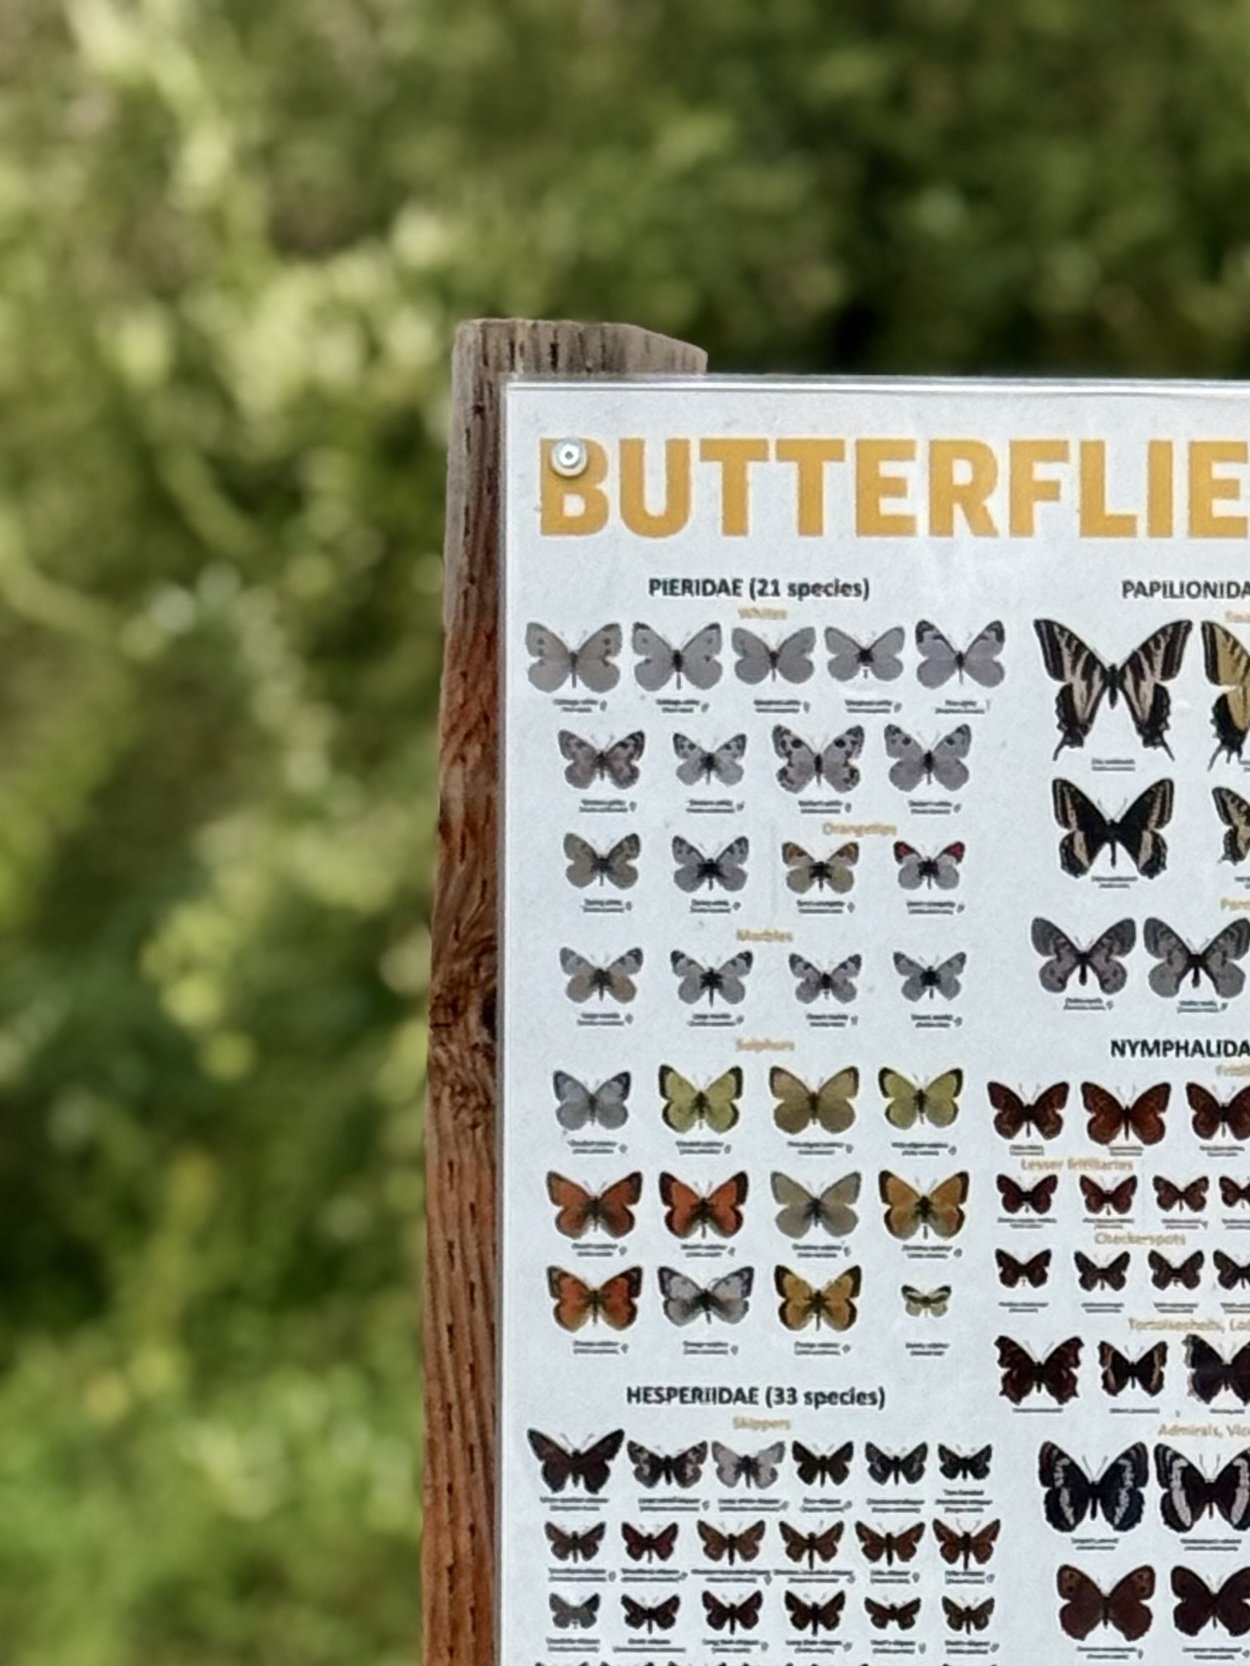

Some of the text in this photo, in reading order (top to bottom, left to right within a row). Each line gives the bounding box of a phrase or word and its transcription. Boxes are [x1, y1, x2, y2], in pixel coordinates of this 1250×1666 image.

[648, 578, 870, 602] PIERIDAE (21 species)
[822, 822, 898, 837] Orangetips
[1020, 1158, 1064, 1172] Lesser
[626, 1386, 886, 1411] HESPERIIDAE (33 species)
